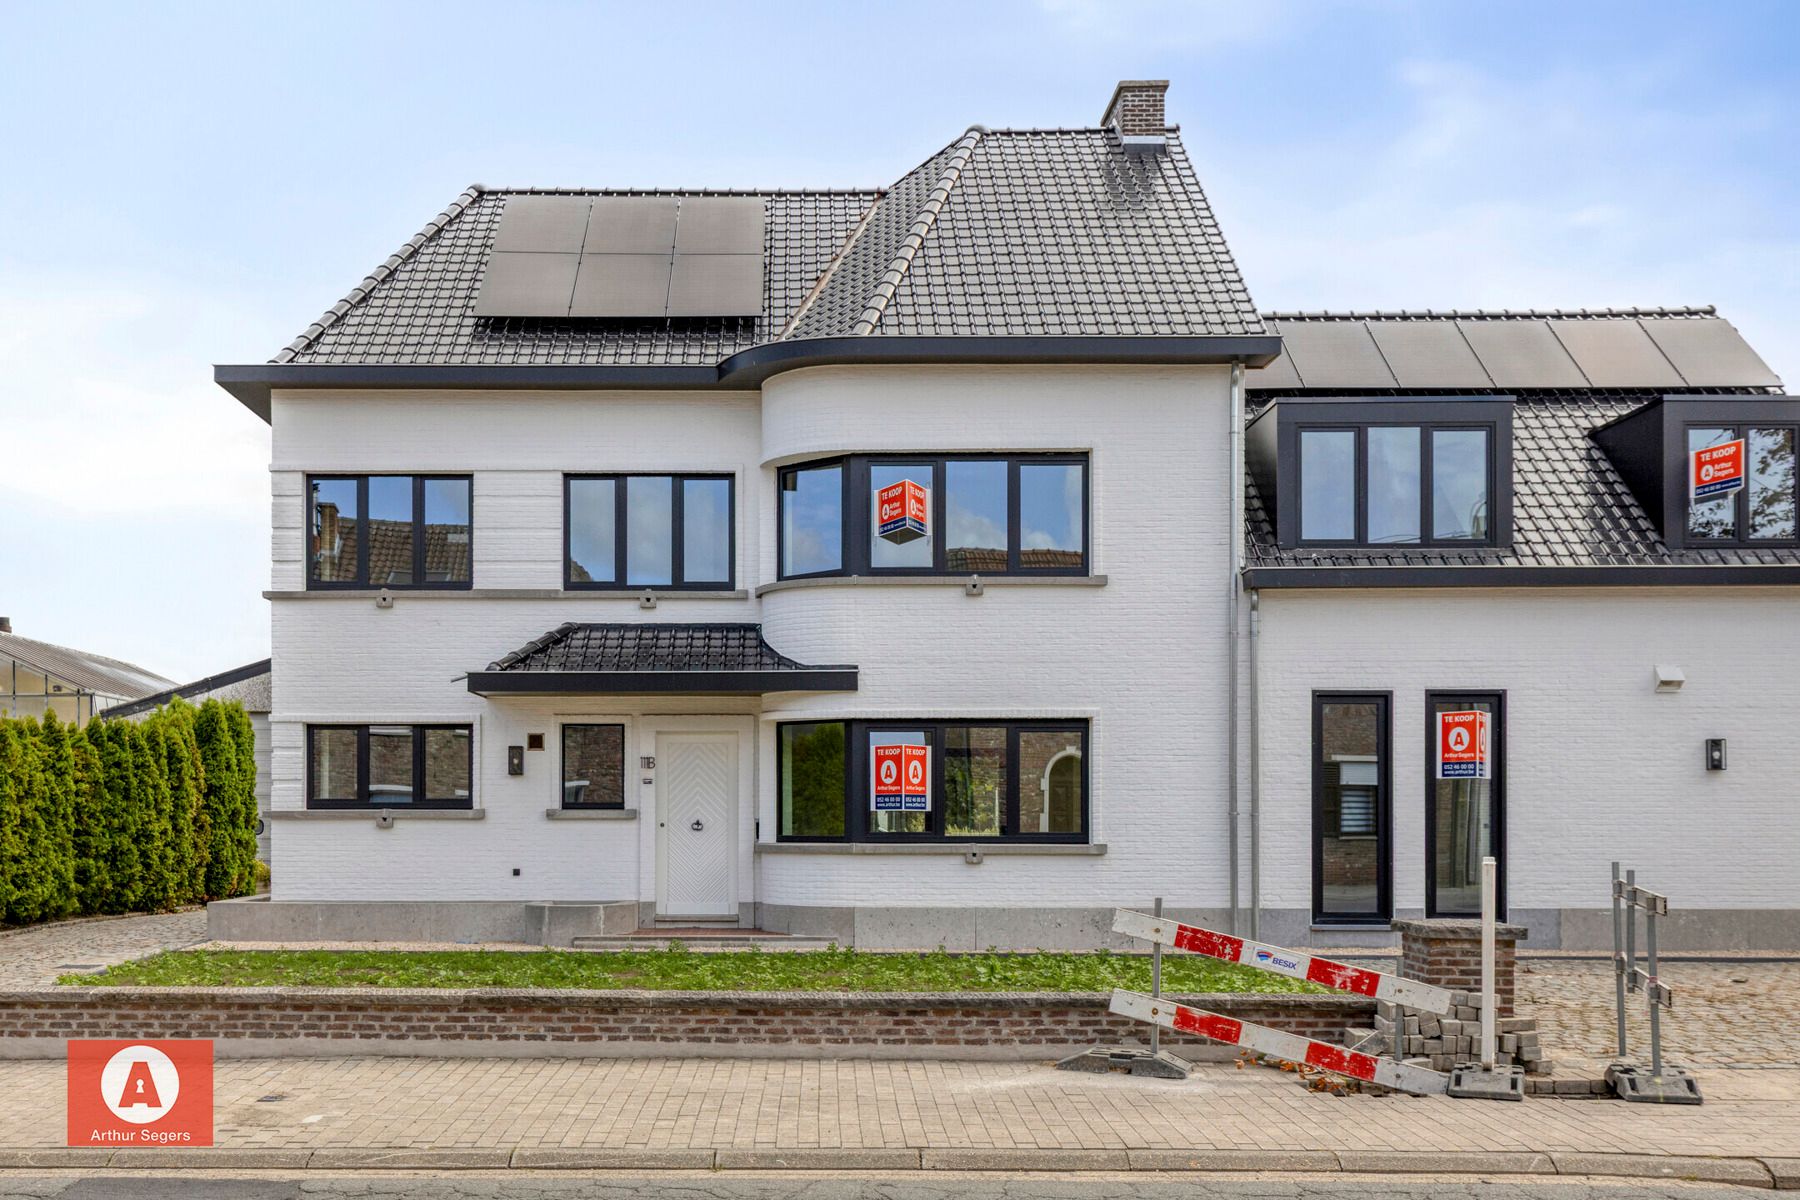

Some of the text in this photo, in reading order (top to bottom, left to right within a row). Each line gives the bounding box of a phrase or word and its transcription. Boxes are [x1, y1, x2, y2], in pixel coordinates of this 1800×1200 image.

[1700, 446, 1736, 462] TE KOOP
[1714, 461, 1733, 470] Arthur
[881, 486, 902, 500] TE KOOP
[1444, 715, 1453, 723] TE
[1453, 731, 1465, 747] A
[885, 748, 900, 756] KOOP
[640, 756, 656, 769] 111B
[1272, 957, 1297, 970] BESIX
